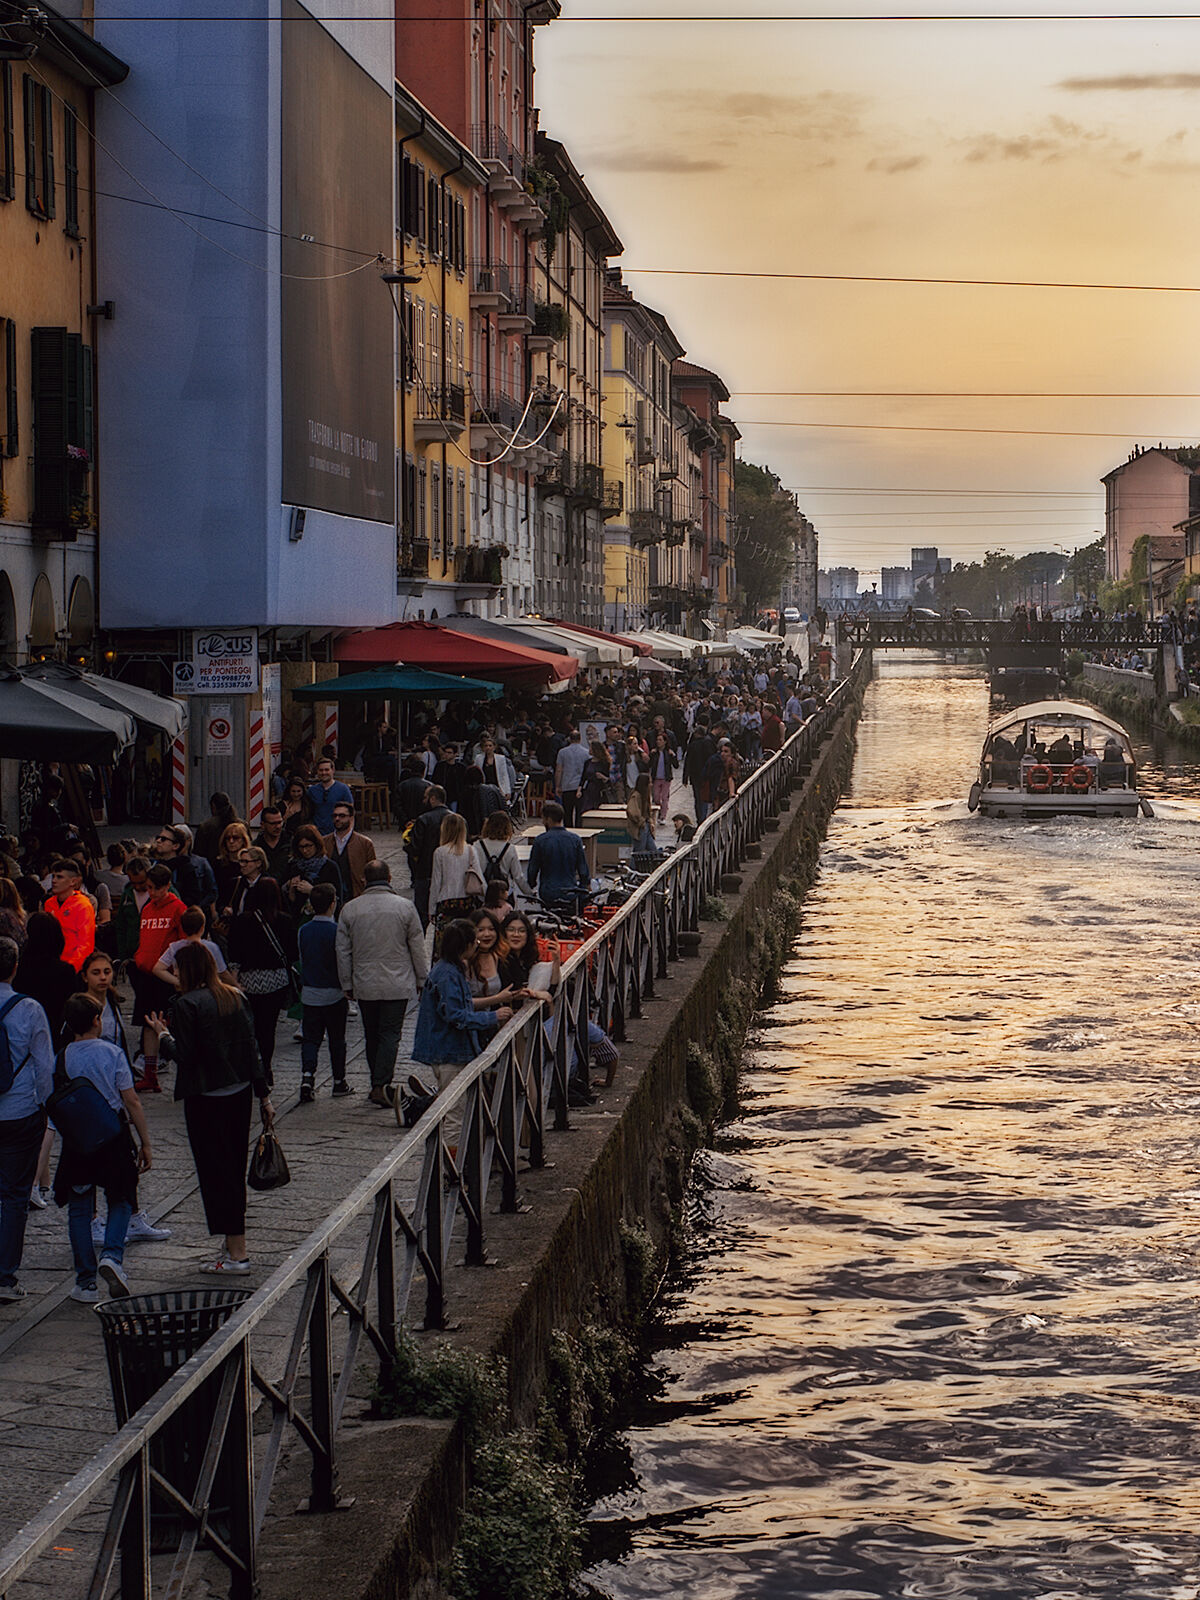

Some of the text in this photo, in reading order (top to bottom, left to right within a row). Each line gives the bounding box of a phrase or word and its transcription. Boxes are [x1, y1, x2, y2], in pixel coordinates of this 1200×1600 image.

[198, 634, 253, 658] FOCUS
[209, 658, 244, 667] ANTIFURTI
[200, 666, 251, 675] PER PONTEGGI
